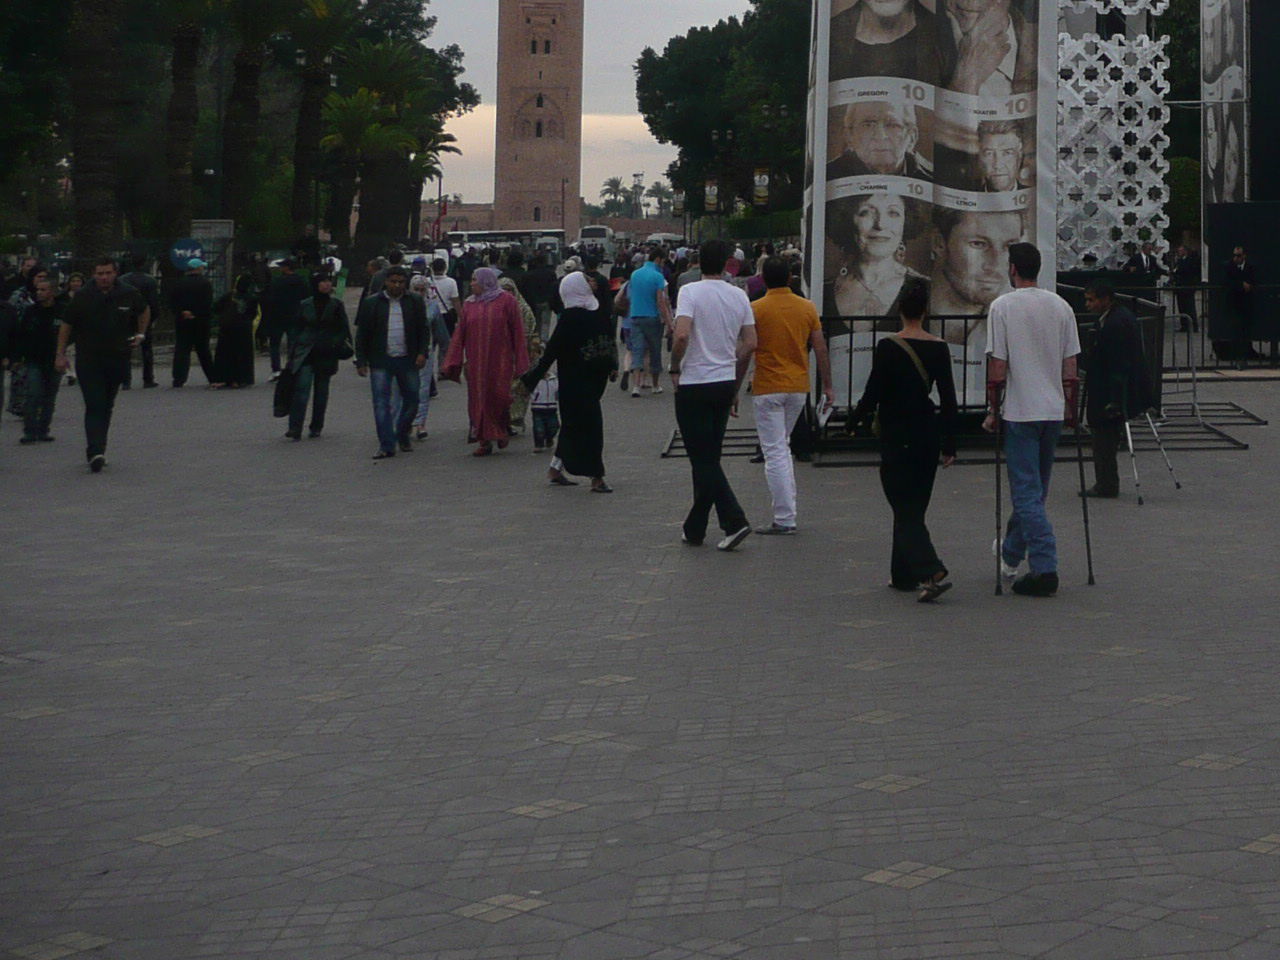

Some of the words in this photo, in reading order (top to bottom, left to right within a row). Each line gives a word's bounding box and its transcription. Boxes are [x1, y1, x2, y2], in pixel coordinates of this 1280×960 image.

[901, 83, 926, 101] 10
[1005, 98, 1029, 115] 10
[907, 183, 924, 195] 10
[1012, 193, 1027, 206] 10
